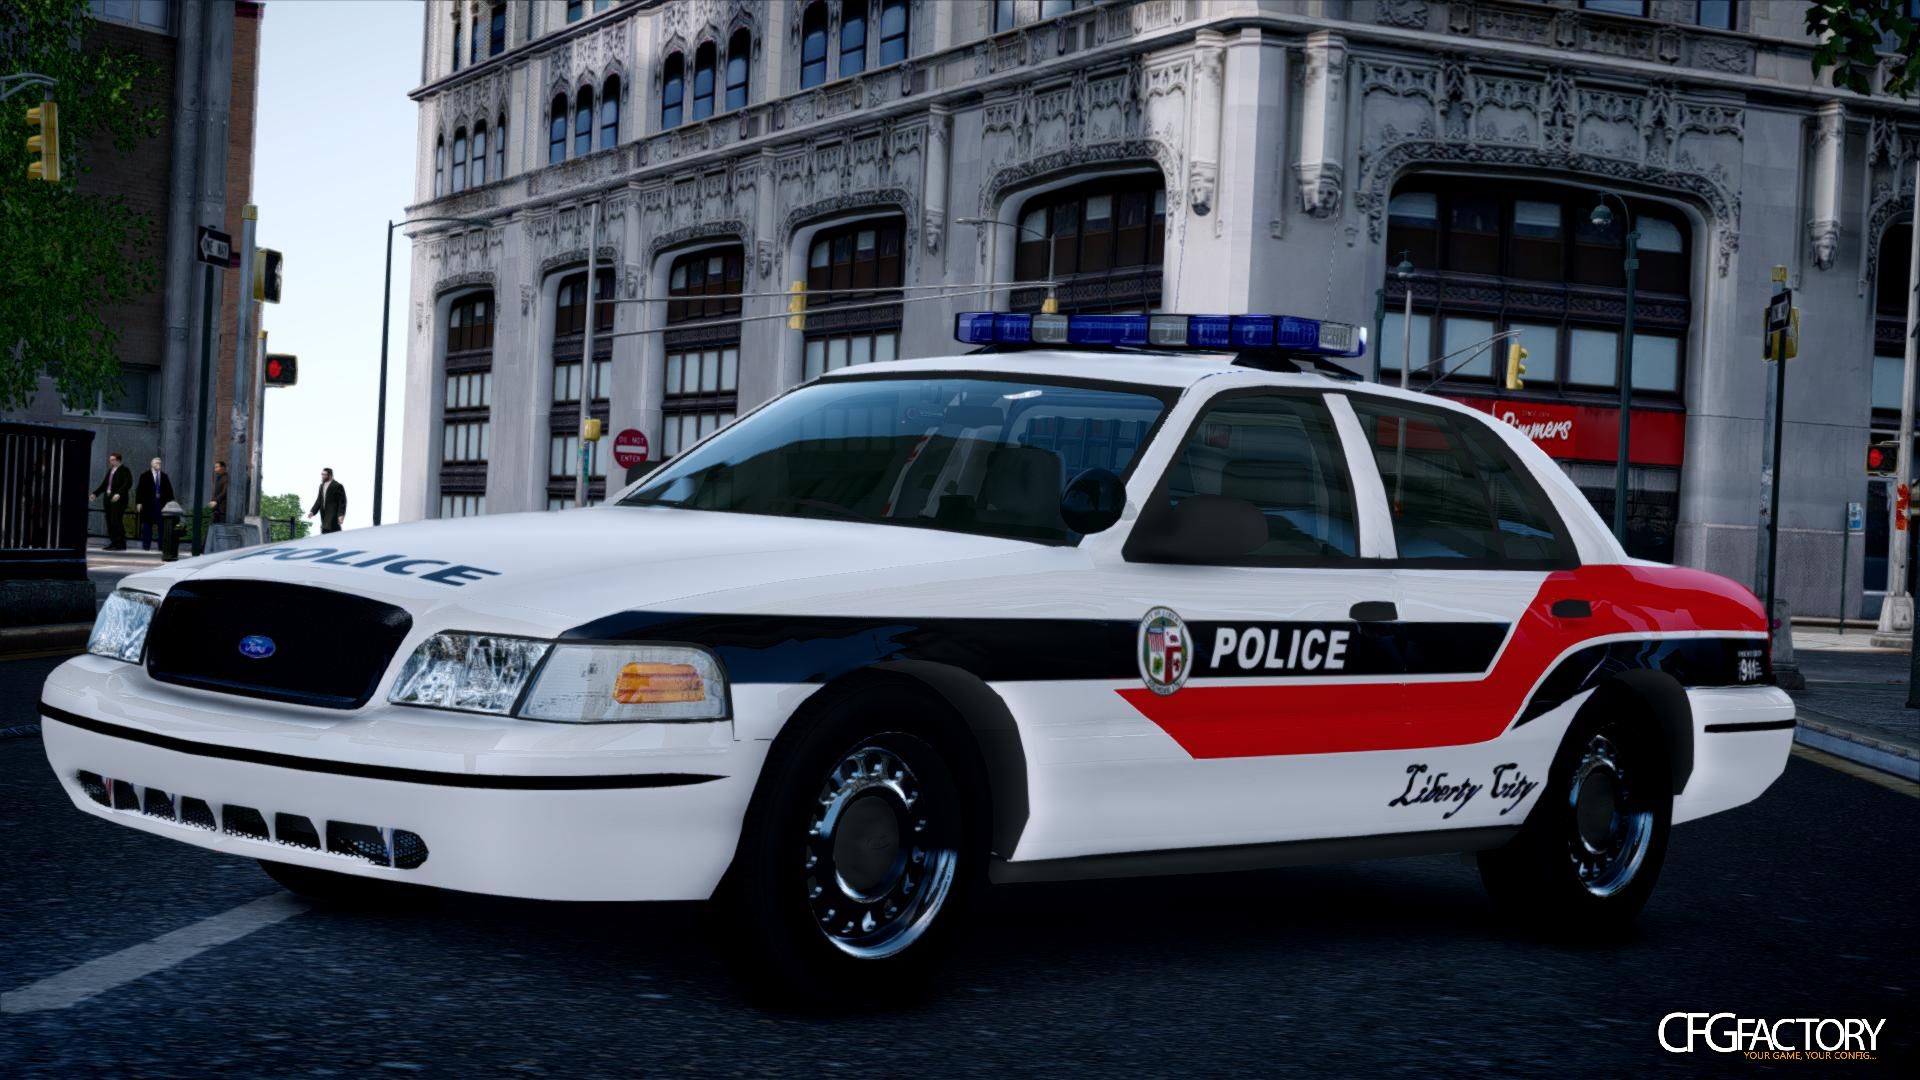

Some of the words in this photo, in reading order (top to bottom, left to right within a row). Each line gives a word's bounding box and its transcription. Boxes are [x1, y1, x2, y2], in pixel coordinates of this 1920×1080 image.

[632, 436, 645, 444] NOT
[1502, 411, 1572, 441] mmers
[231, 547, 502, 586] POLICE
[1210, 627, 1350, 670] POLICE
[1388, 764, 1483, 819] Liberty
[1490, 763, 1540, 816] City
